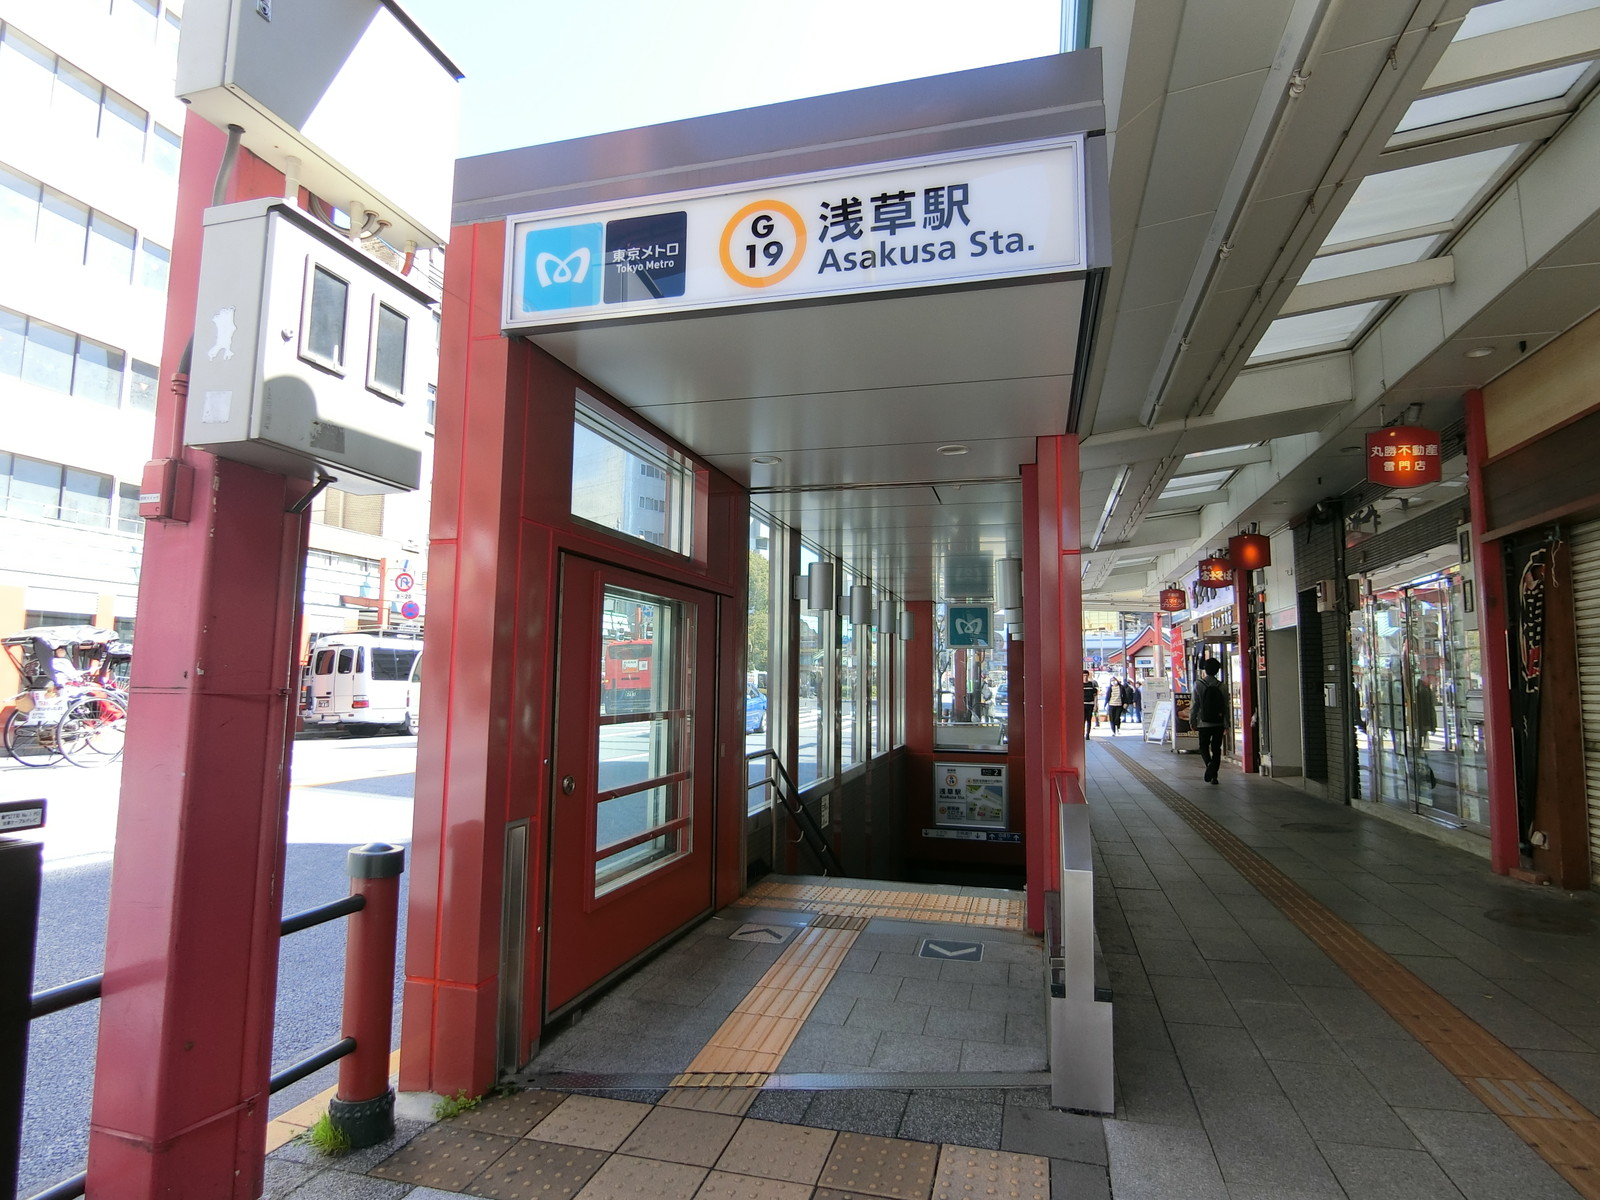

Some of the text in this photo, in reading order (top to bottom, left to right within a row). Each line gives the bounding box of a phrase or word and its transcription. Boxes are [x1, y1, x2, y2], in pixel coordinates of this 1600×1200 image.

[818, 183, 970, 245] 浅草駅
[751, 214, 775, 239] G
[612, 243, 679, 263] 東京メトロ
[745, 241, 785, 269] 19
[818, 227, 1035, 275] Asakusa Sta.
[616, 260, 675, 274] Tokyo Metro
[1370, 444, 1438, 457] 丸勝不動産
[1383, 460, 1426, 471] 雷門店
[1200, 569, 1233, 581] 富士そば
